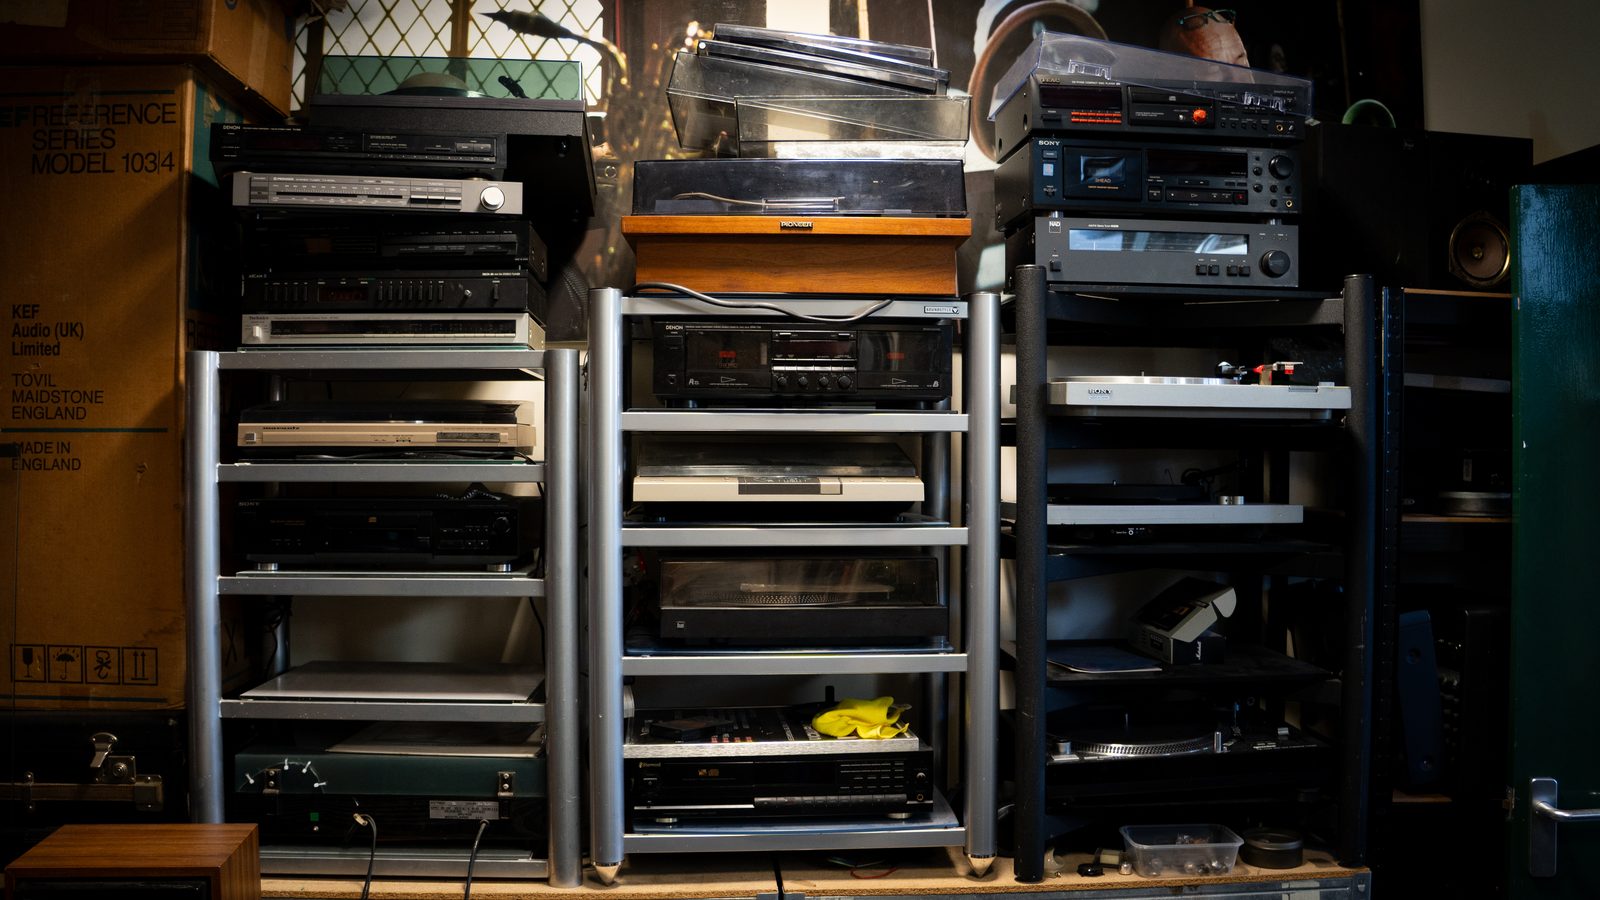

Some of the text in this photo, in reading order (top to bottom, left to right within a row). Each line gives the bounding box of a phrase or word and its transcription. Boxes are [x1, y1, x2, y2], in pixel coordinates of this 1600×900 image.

[33, 129, 116, 150] SERIES
[32, 153, 114, 174] MODEL
[12, 304, 40, 318] KEF
[12, 322, 84, 340] Audio (UK)
[12, 342, 60, 355] Limited
[13, 374, 56, 386] TOVIL
[12, 391, 104, 403] MAIDSTONE
[12, 406, 87, 419] ENGLAND
[56, 442, 70, 454] IN
[12, 458, 81, 471] ENGLAND
